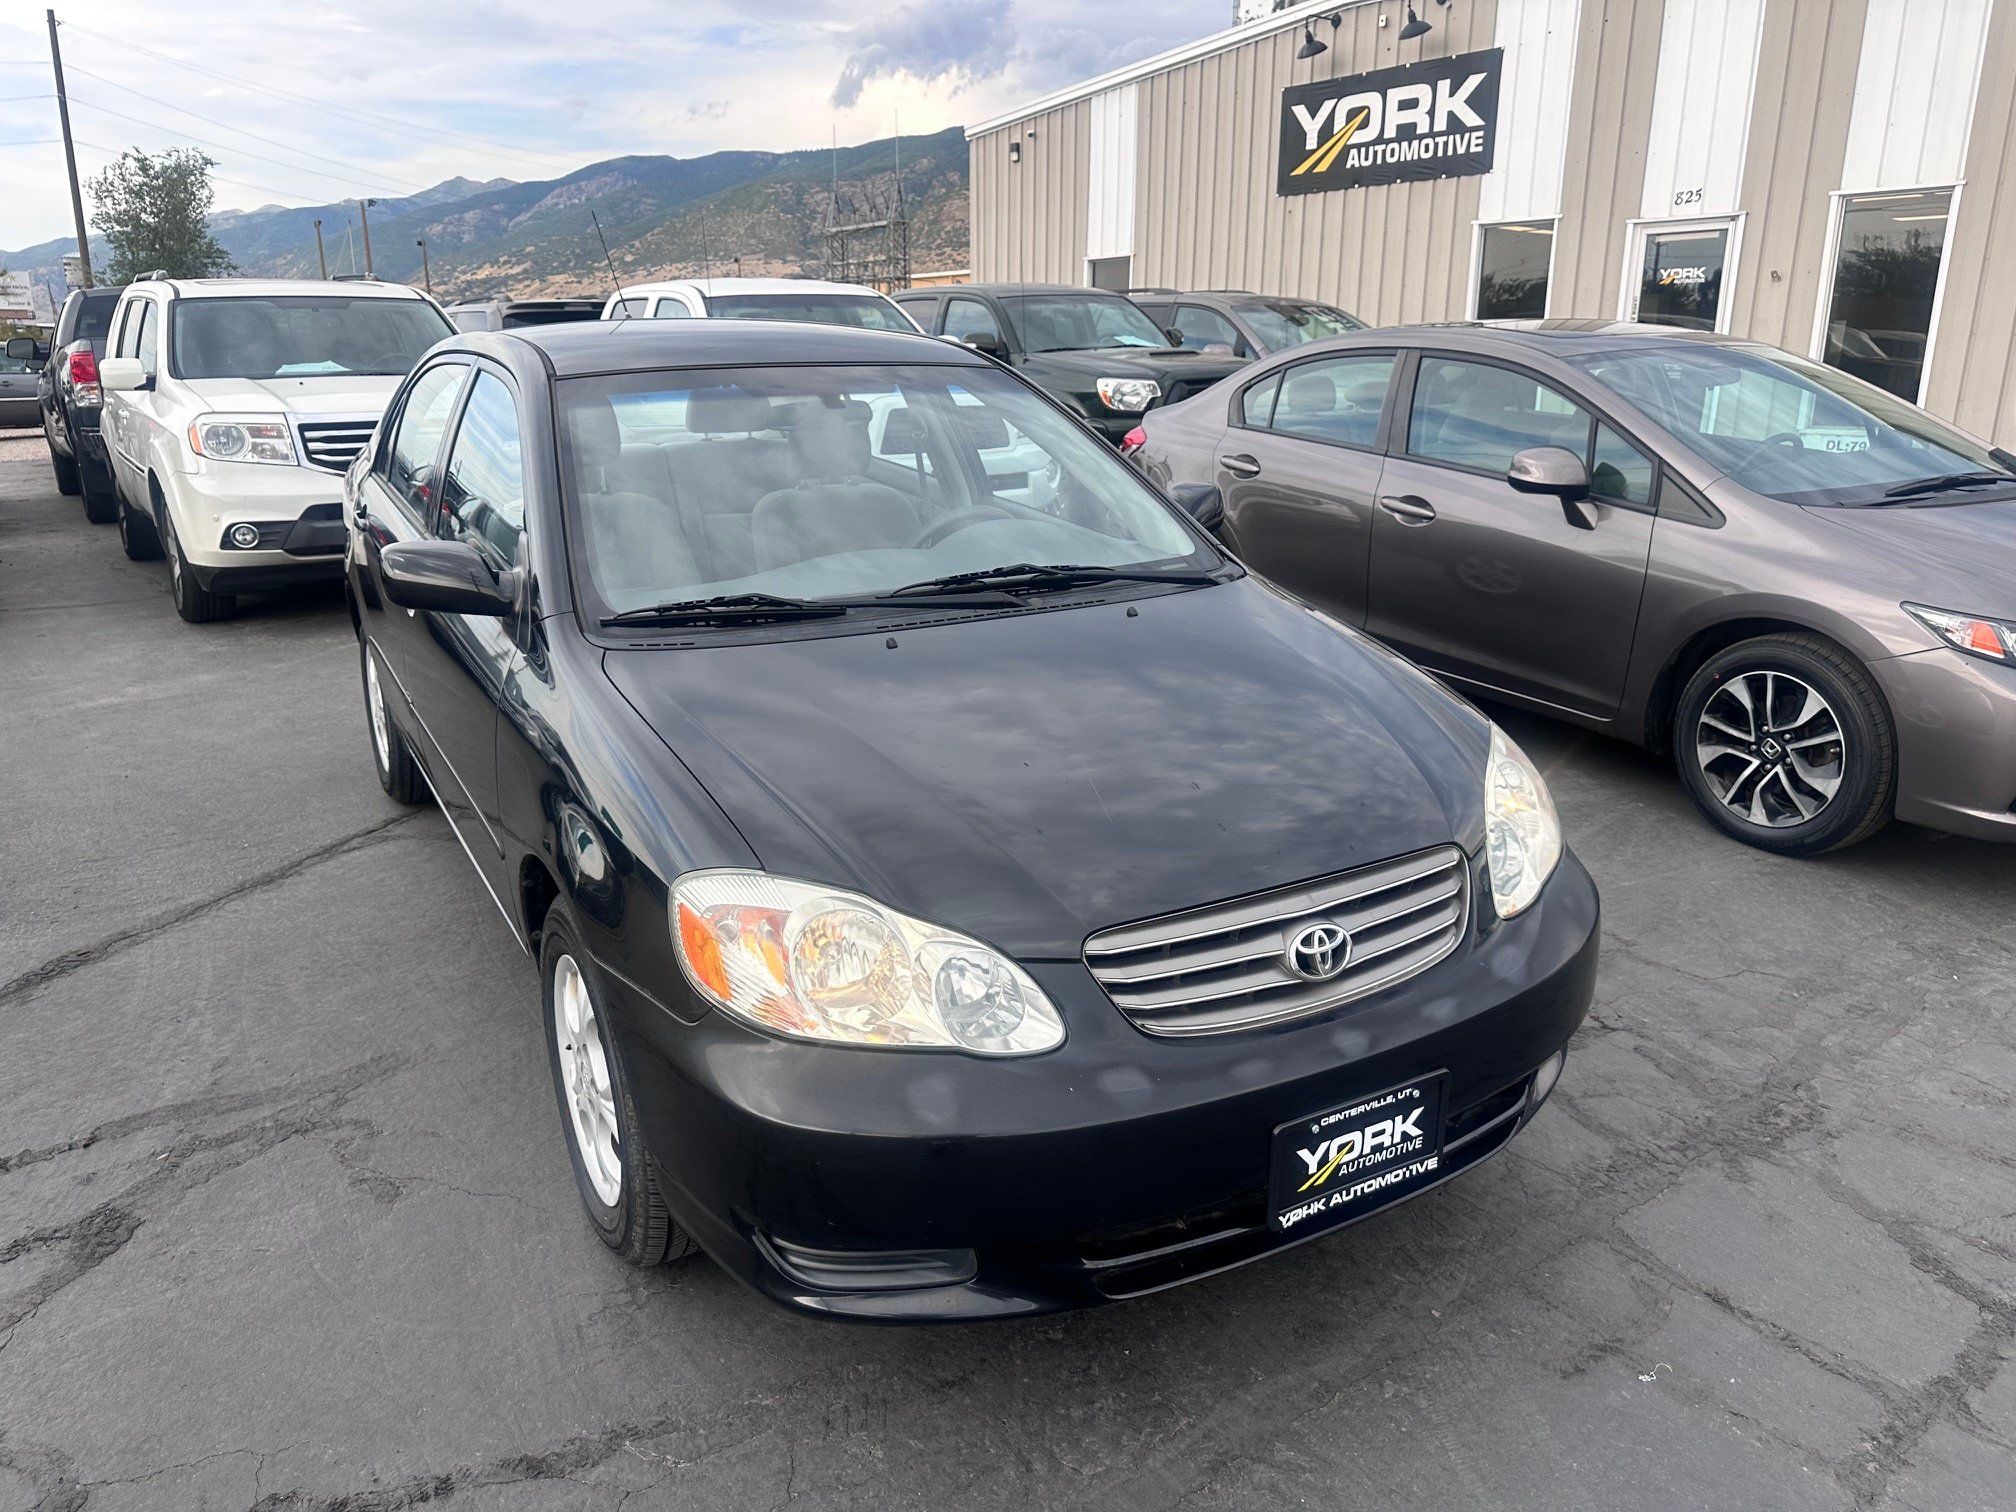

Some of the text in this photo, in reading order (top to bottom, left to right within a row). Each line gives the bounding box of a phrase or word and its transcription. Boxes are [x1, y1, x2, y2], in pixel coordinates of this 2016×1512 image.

[1291, 72, 1487, 150] YORK
[1345, 131, 1484, 169] AUTOMOTIVE
[1674, 188, 1703, 206] 825
[1659, 266, 1706, 279] YORK
[1320, 1088, 1412, 1127] CENTERVILLE, UT
[1296, 1106, 1425, 1175] YORK
[1338, 1136, 1424, 1177] AUTOMOTIVE
[1329, 1156, 1439, 1207] AUTOMOTIVE
